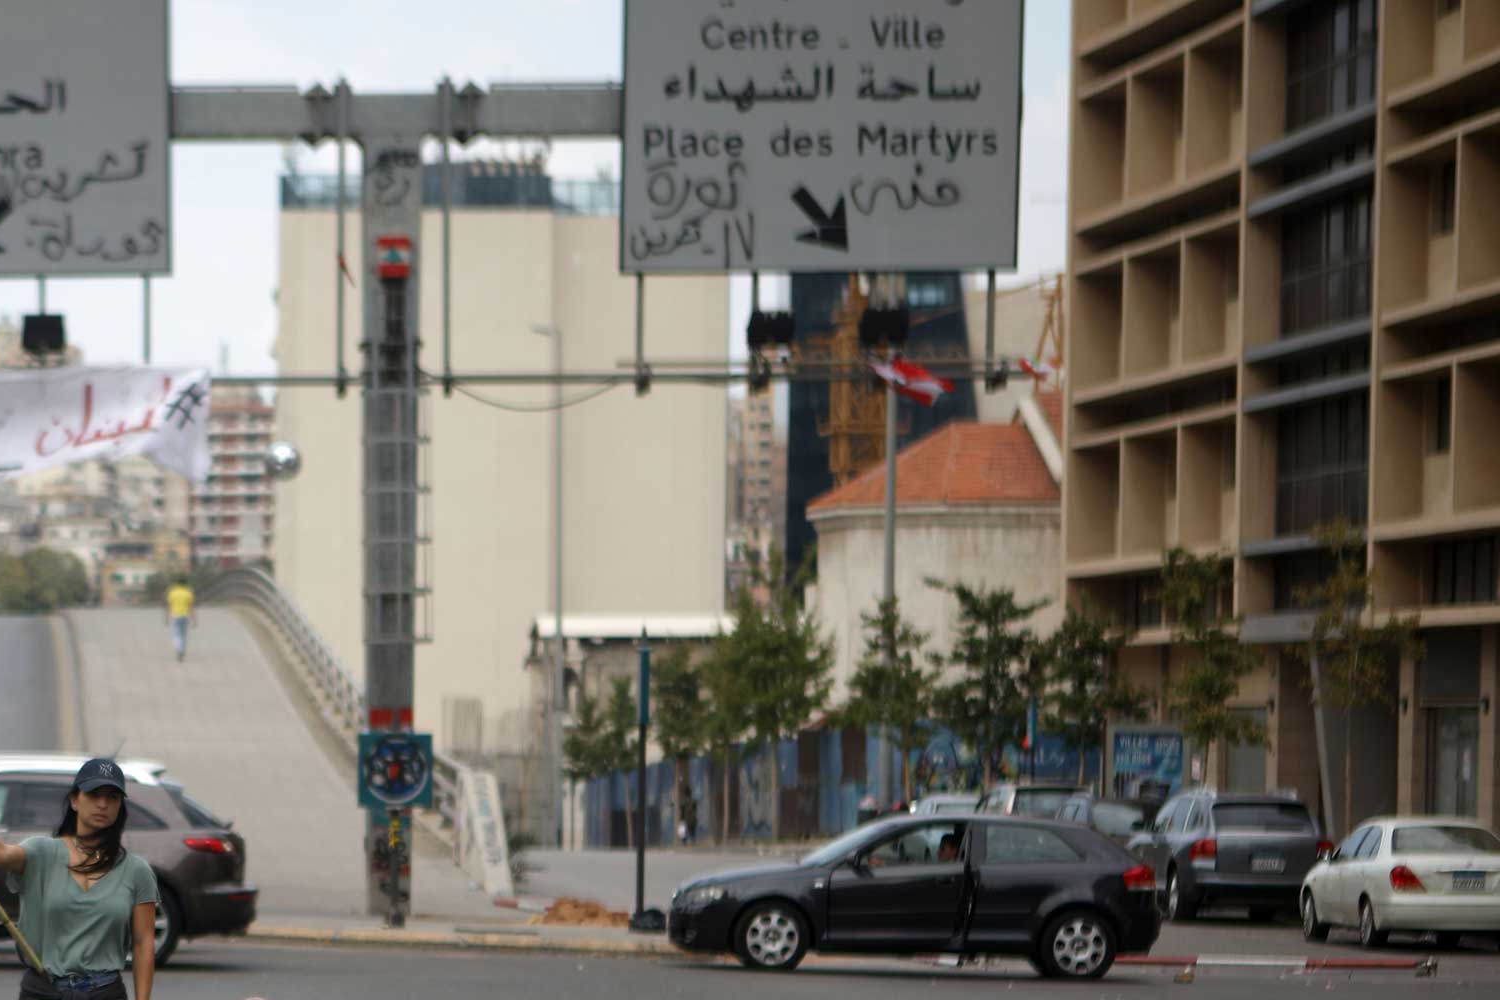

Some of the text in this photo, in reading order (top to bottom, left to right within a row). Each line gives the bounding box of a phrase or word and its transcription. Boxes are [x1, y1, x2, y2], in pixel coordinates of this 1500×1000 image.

[701, 19, 821, 50] Centre
[870, 16, 946, 50] Ville
[663, 61, 982, 113] ساحة الشهداء
[642, 123, 999, 163] Place des Martyrs
